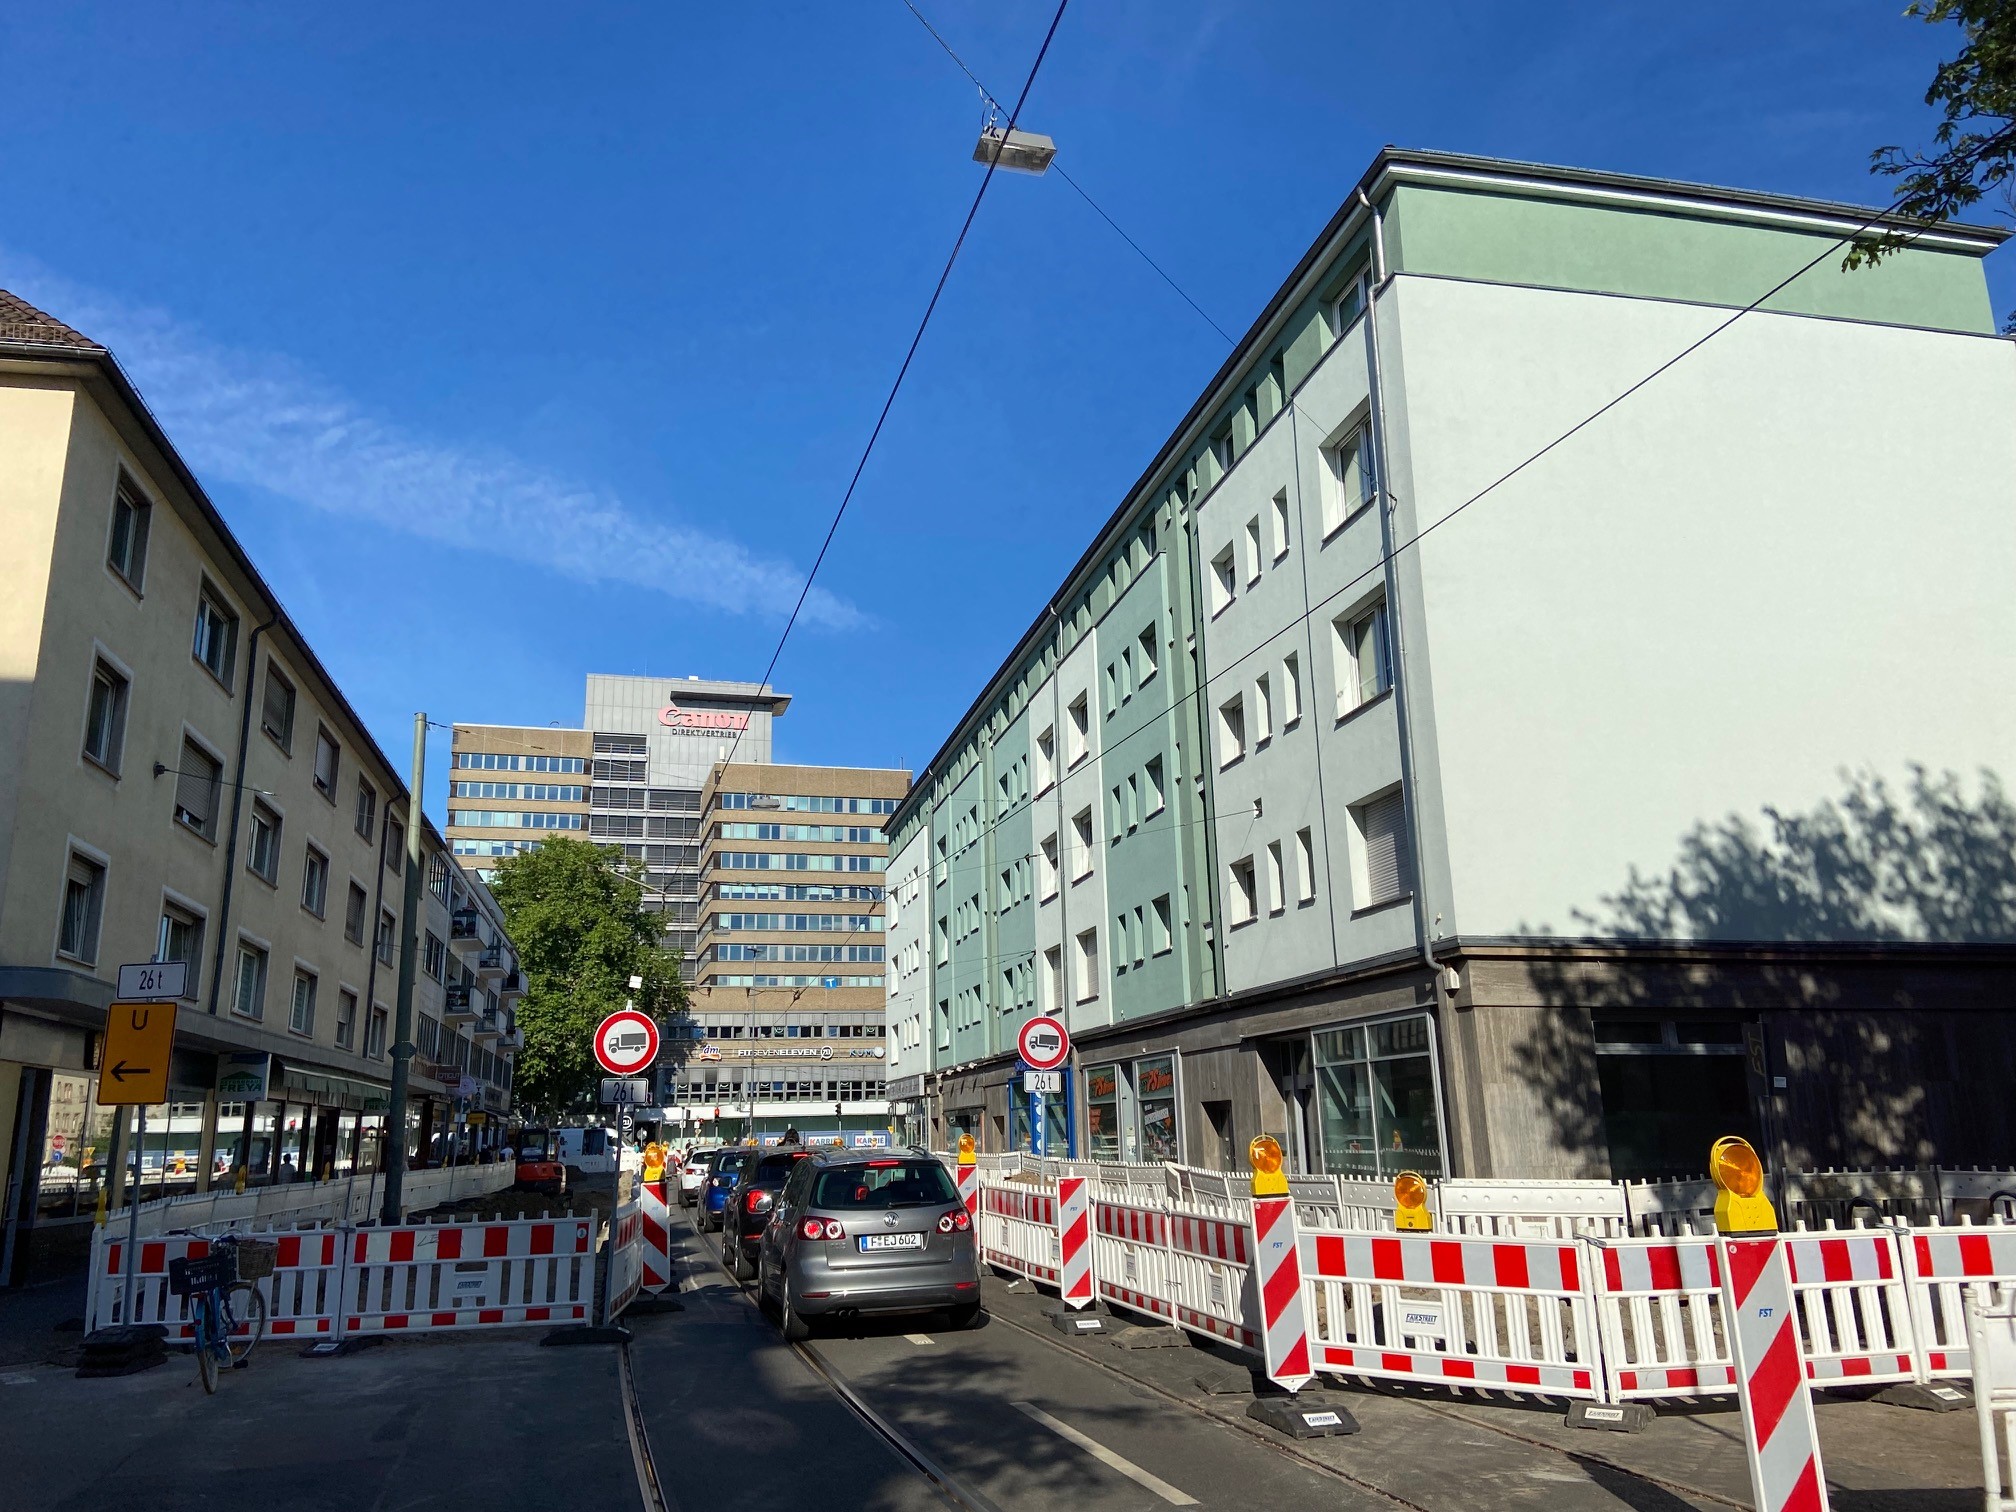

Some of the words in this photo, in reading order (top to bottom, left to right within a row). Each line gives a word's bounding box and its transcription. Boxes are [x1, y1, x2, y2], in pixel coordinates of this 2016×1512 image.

[658, 706, 749, 730] Canon
[672, 729, 737, 738] DIREKTVERTRIEB
[139, 969, 154, 991] 26
[158, 970, 162, 989] t
[131, 1009, 149, 1031] U
[703, 1044, 719, 1054] dm
[219, 1084, 262, 1092] FREYA
[1034, 1073, 1046, 1090] 26
[1048, 1075, 1052, 1089] t
[612, 1081, 627, 1102] 26
[630, 1083, 634, 1101] t
[870, 1236, 876, 1247] F
[883, 1235, 897, 1247] EJ
[898, 1234, 918, 1246] 602
[1272, 1241, 1283, 1249] FST
[1758, 1308, 1774, 1318] FST
